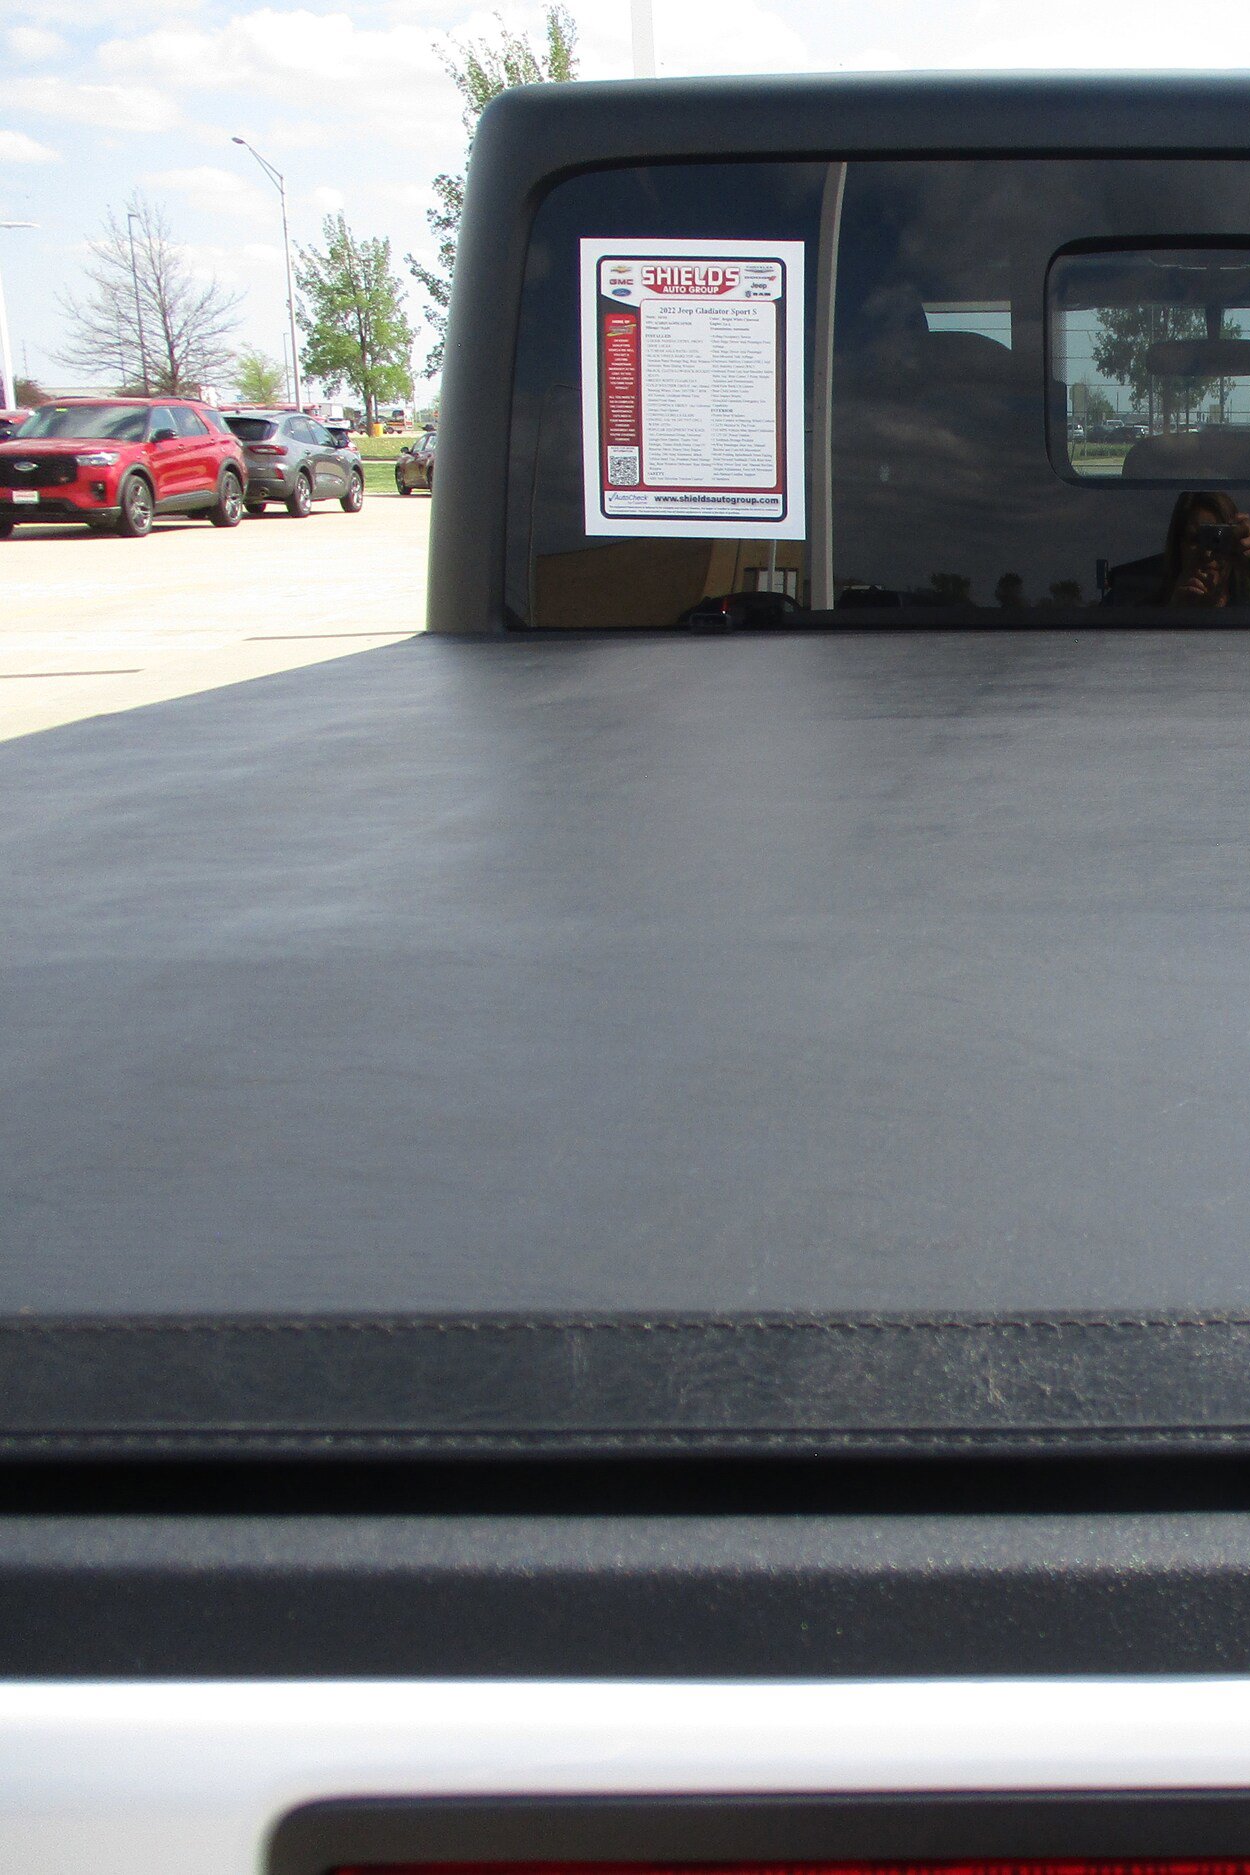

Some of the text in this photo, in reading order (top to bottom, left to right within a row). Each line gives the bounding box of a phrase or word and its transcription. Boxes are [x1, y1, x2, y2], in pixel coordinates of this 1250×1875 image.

[641, 266, 741, 287] SHIELDS
[688, 286, 719, 294] GROUP
[750, 282, 767, 290] Jeep
[677, 307, 694, 316] Jeep
[695, 307, 729, 315] Gladiator
[731, 308, 751, 317] Sport
[654, 494, 779, 506] www.shieldsautogroup.com
